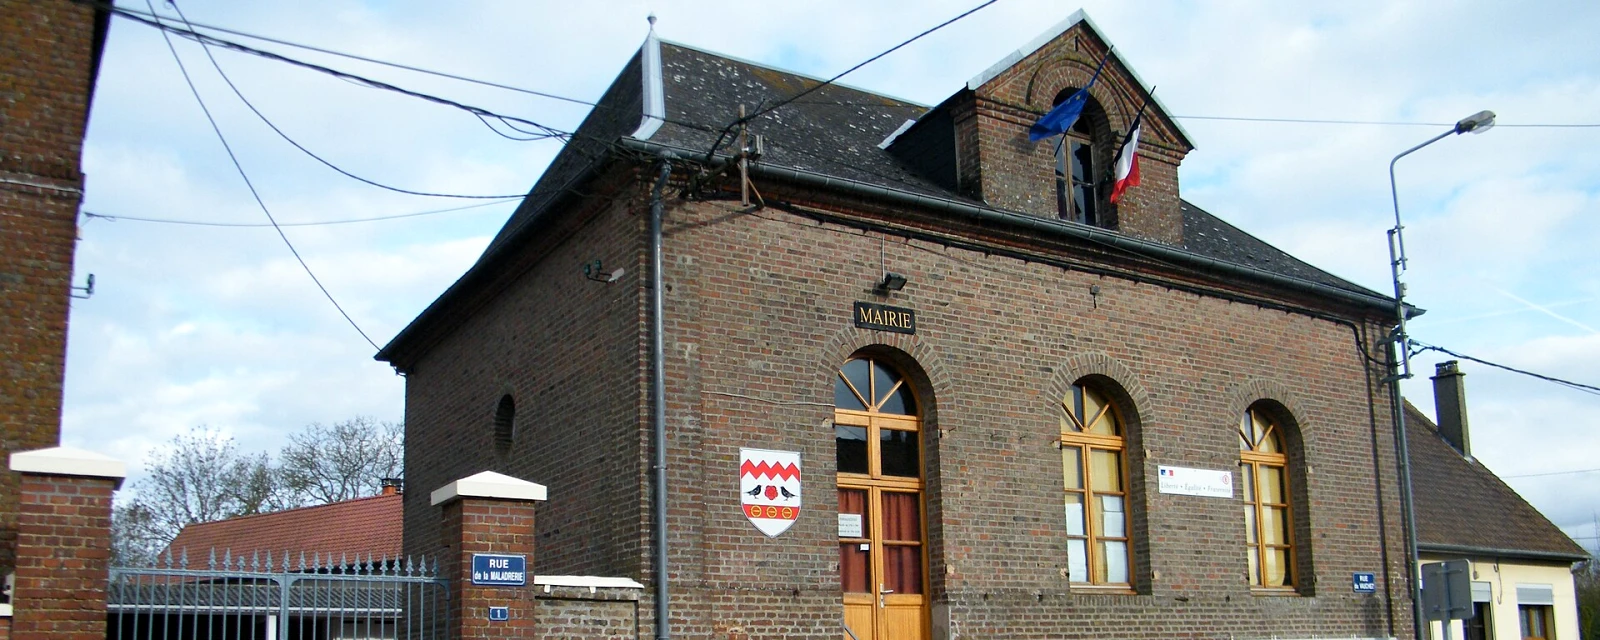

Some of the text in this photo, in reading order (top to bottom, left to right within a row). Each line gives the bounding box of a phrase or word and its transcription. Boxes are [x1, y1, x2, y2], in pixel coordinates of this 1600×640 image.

[859, 306, 912, 329] MAIRIE
[489, 559, 509, 569] RUE
[474, 571, 523, 581] de la MALADRERIE
[496, 609, 501, 618] 1
